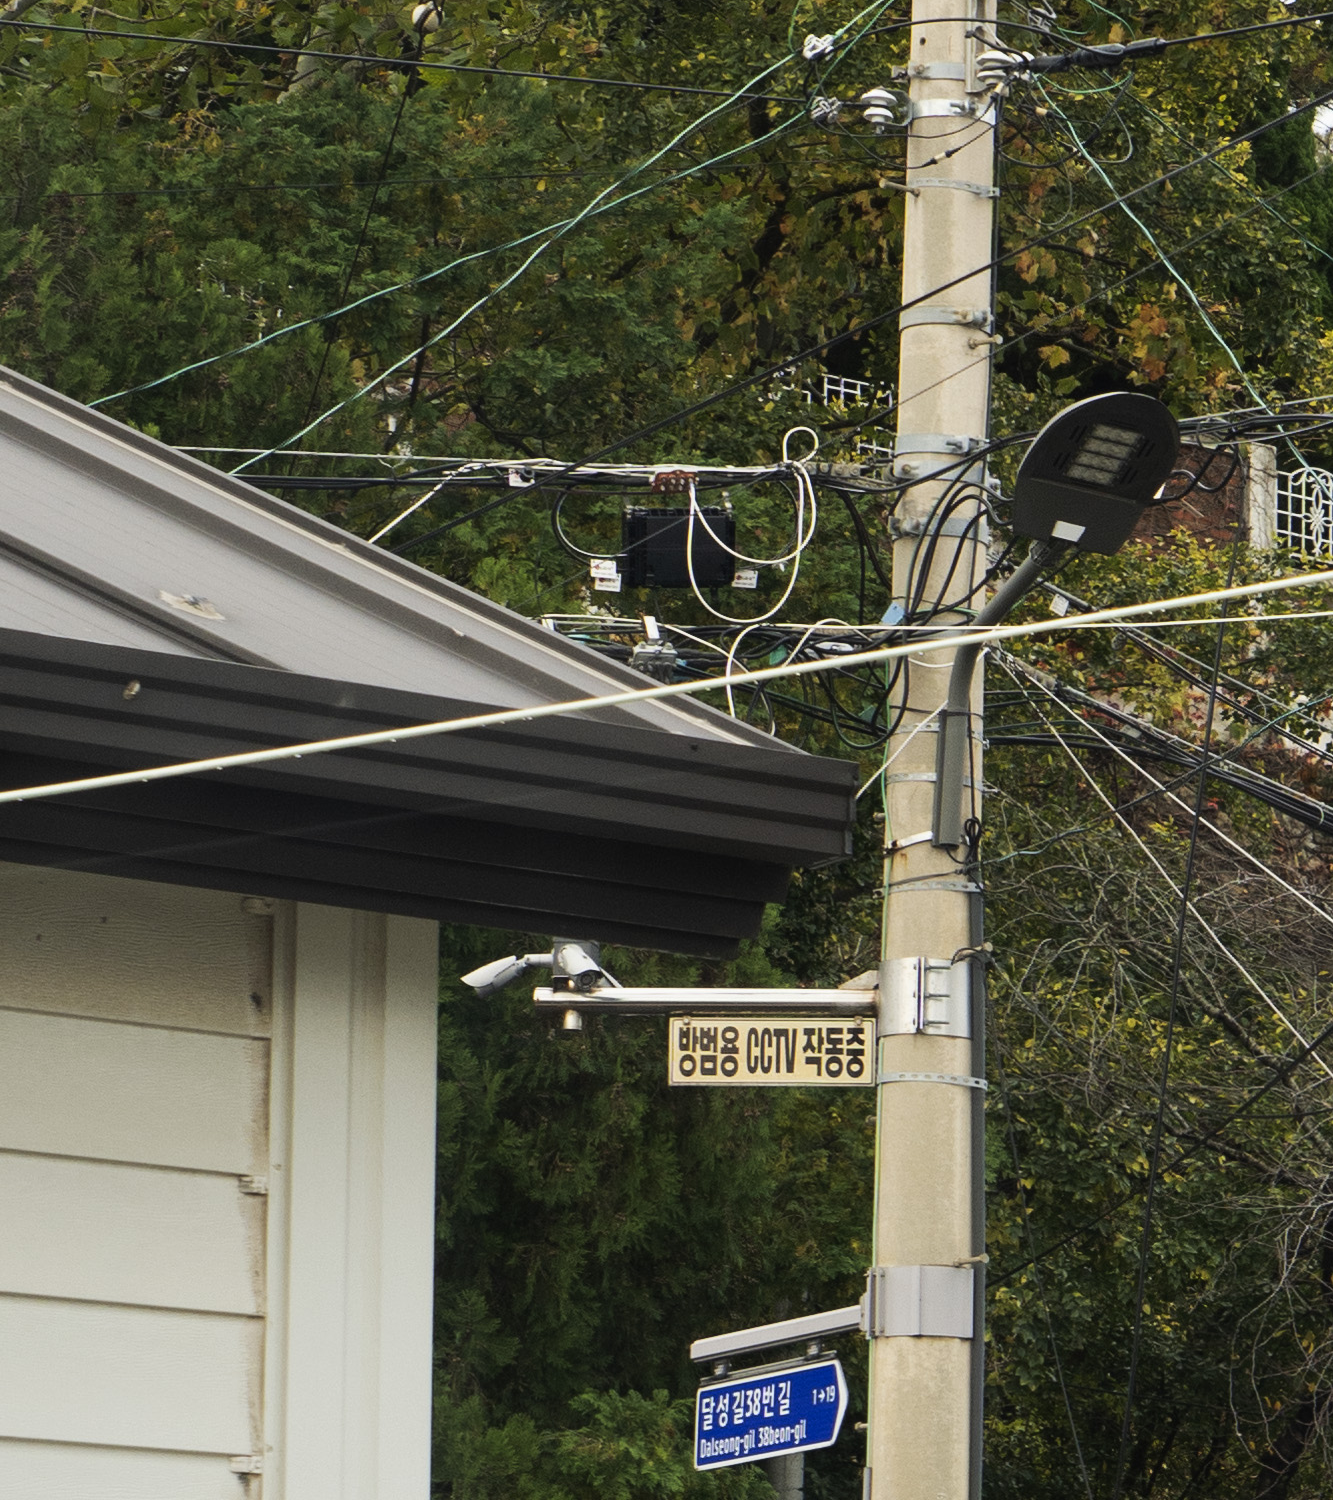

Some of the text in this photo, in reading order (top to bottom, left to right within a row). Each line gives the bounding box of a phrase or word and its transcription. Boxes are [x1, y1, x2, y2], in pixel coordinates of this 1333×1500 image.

[678, 1025, 866, 1079] 방범용 CCTV 작동중
[701, 1380, 791, 1431] 달성길38번길
[700, 1419, 807, 1459] Dalseong-gil 38beon-gil
